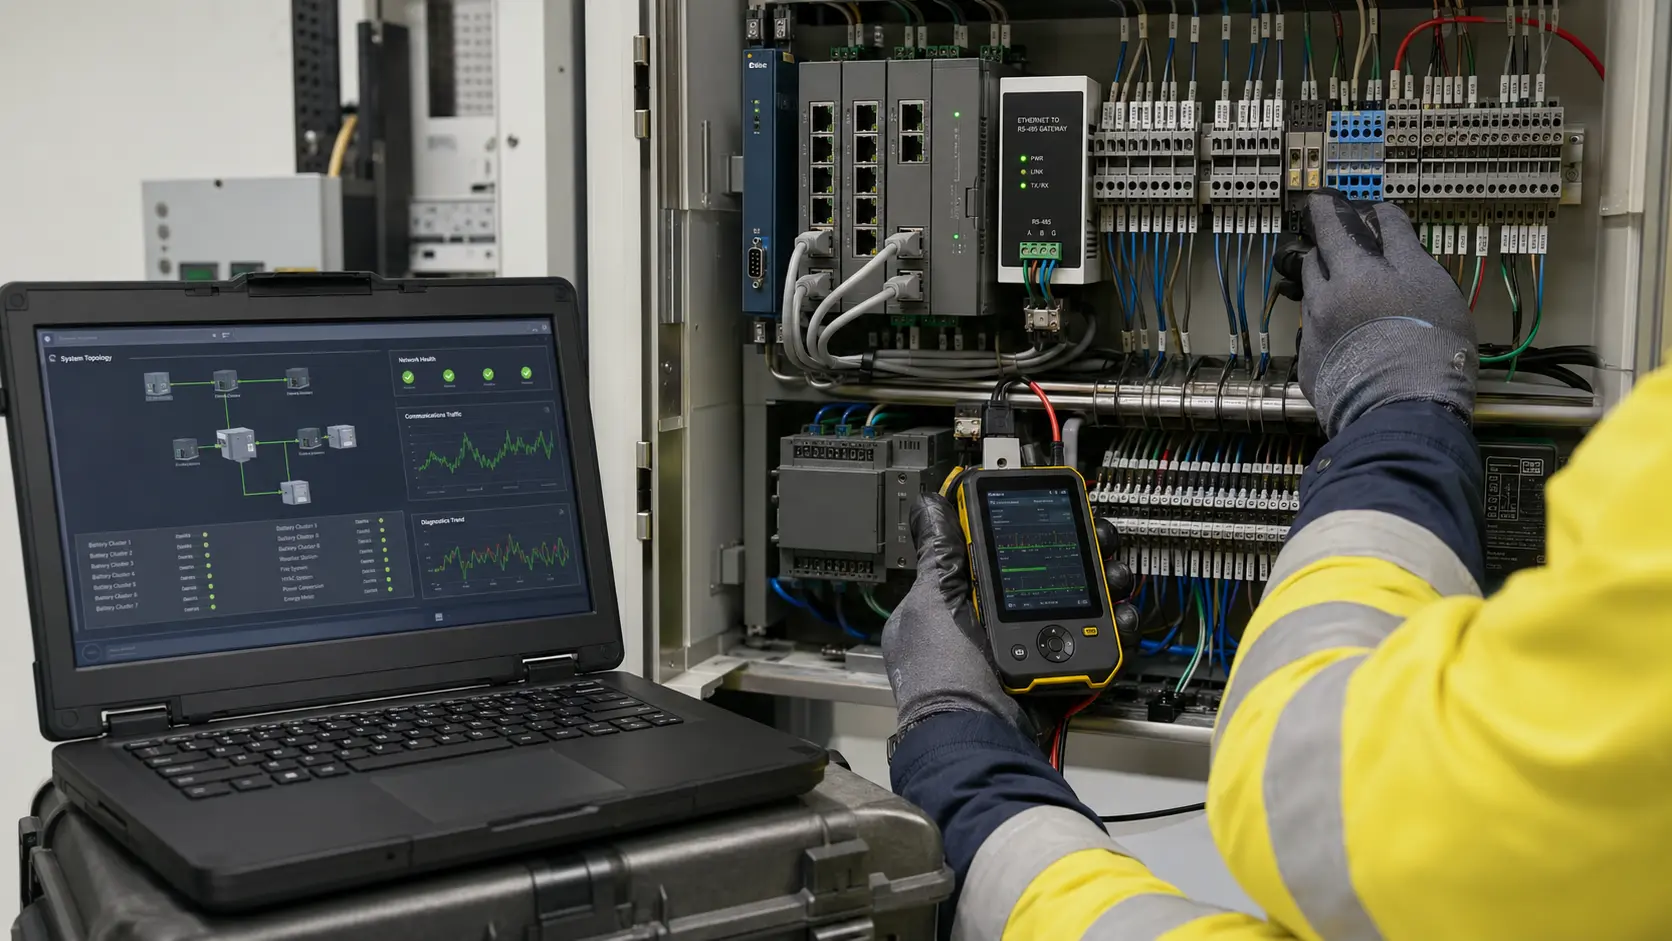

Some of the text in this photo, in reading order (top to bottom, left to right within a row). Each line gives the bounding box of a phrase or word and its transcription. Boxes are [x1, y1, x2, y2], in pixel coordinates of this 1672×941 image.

[1017, 116, 1060, 124] ETHERNET TO
[1017, 125, 1068, 133] RS-485 GATEWAY
[1031, 218, 1052, 226] RS-485
[60, 354, 112, 363] System Topology
[398, 355, 437, 364] Network Health
[404, 411, 463, 420] Communications Traffic
[420, 516, 465, 527] Diagnostics Trend
